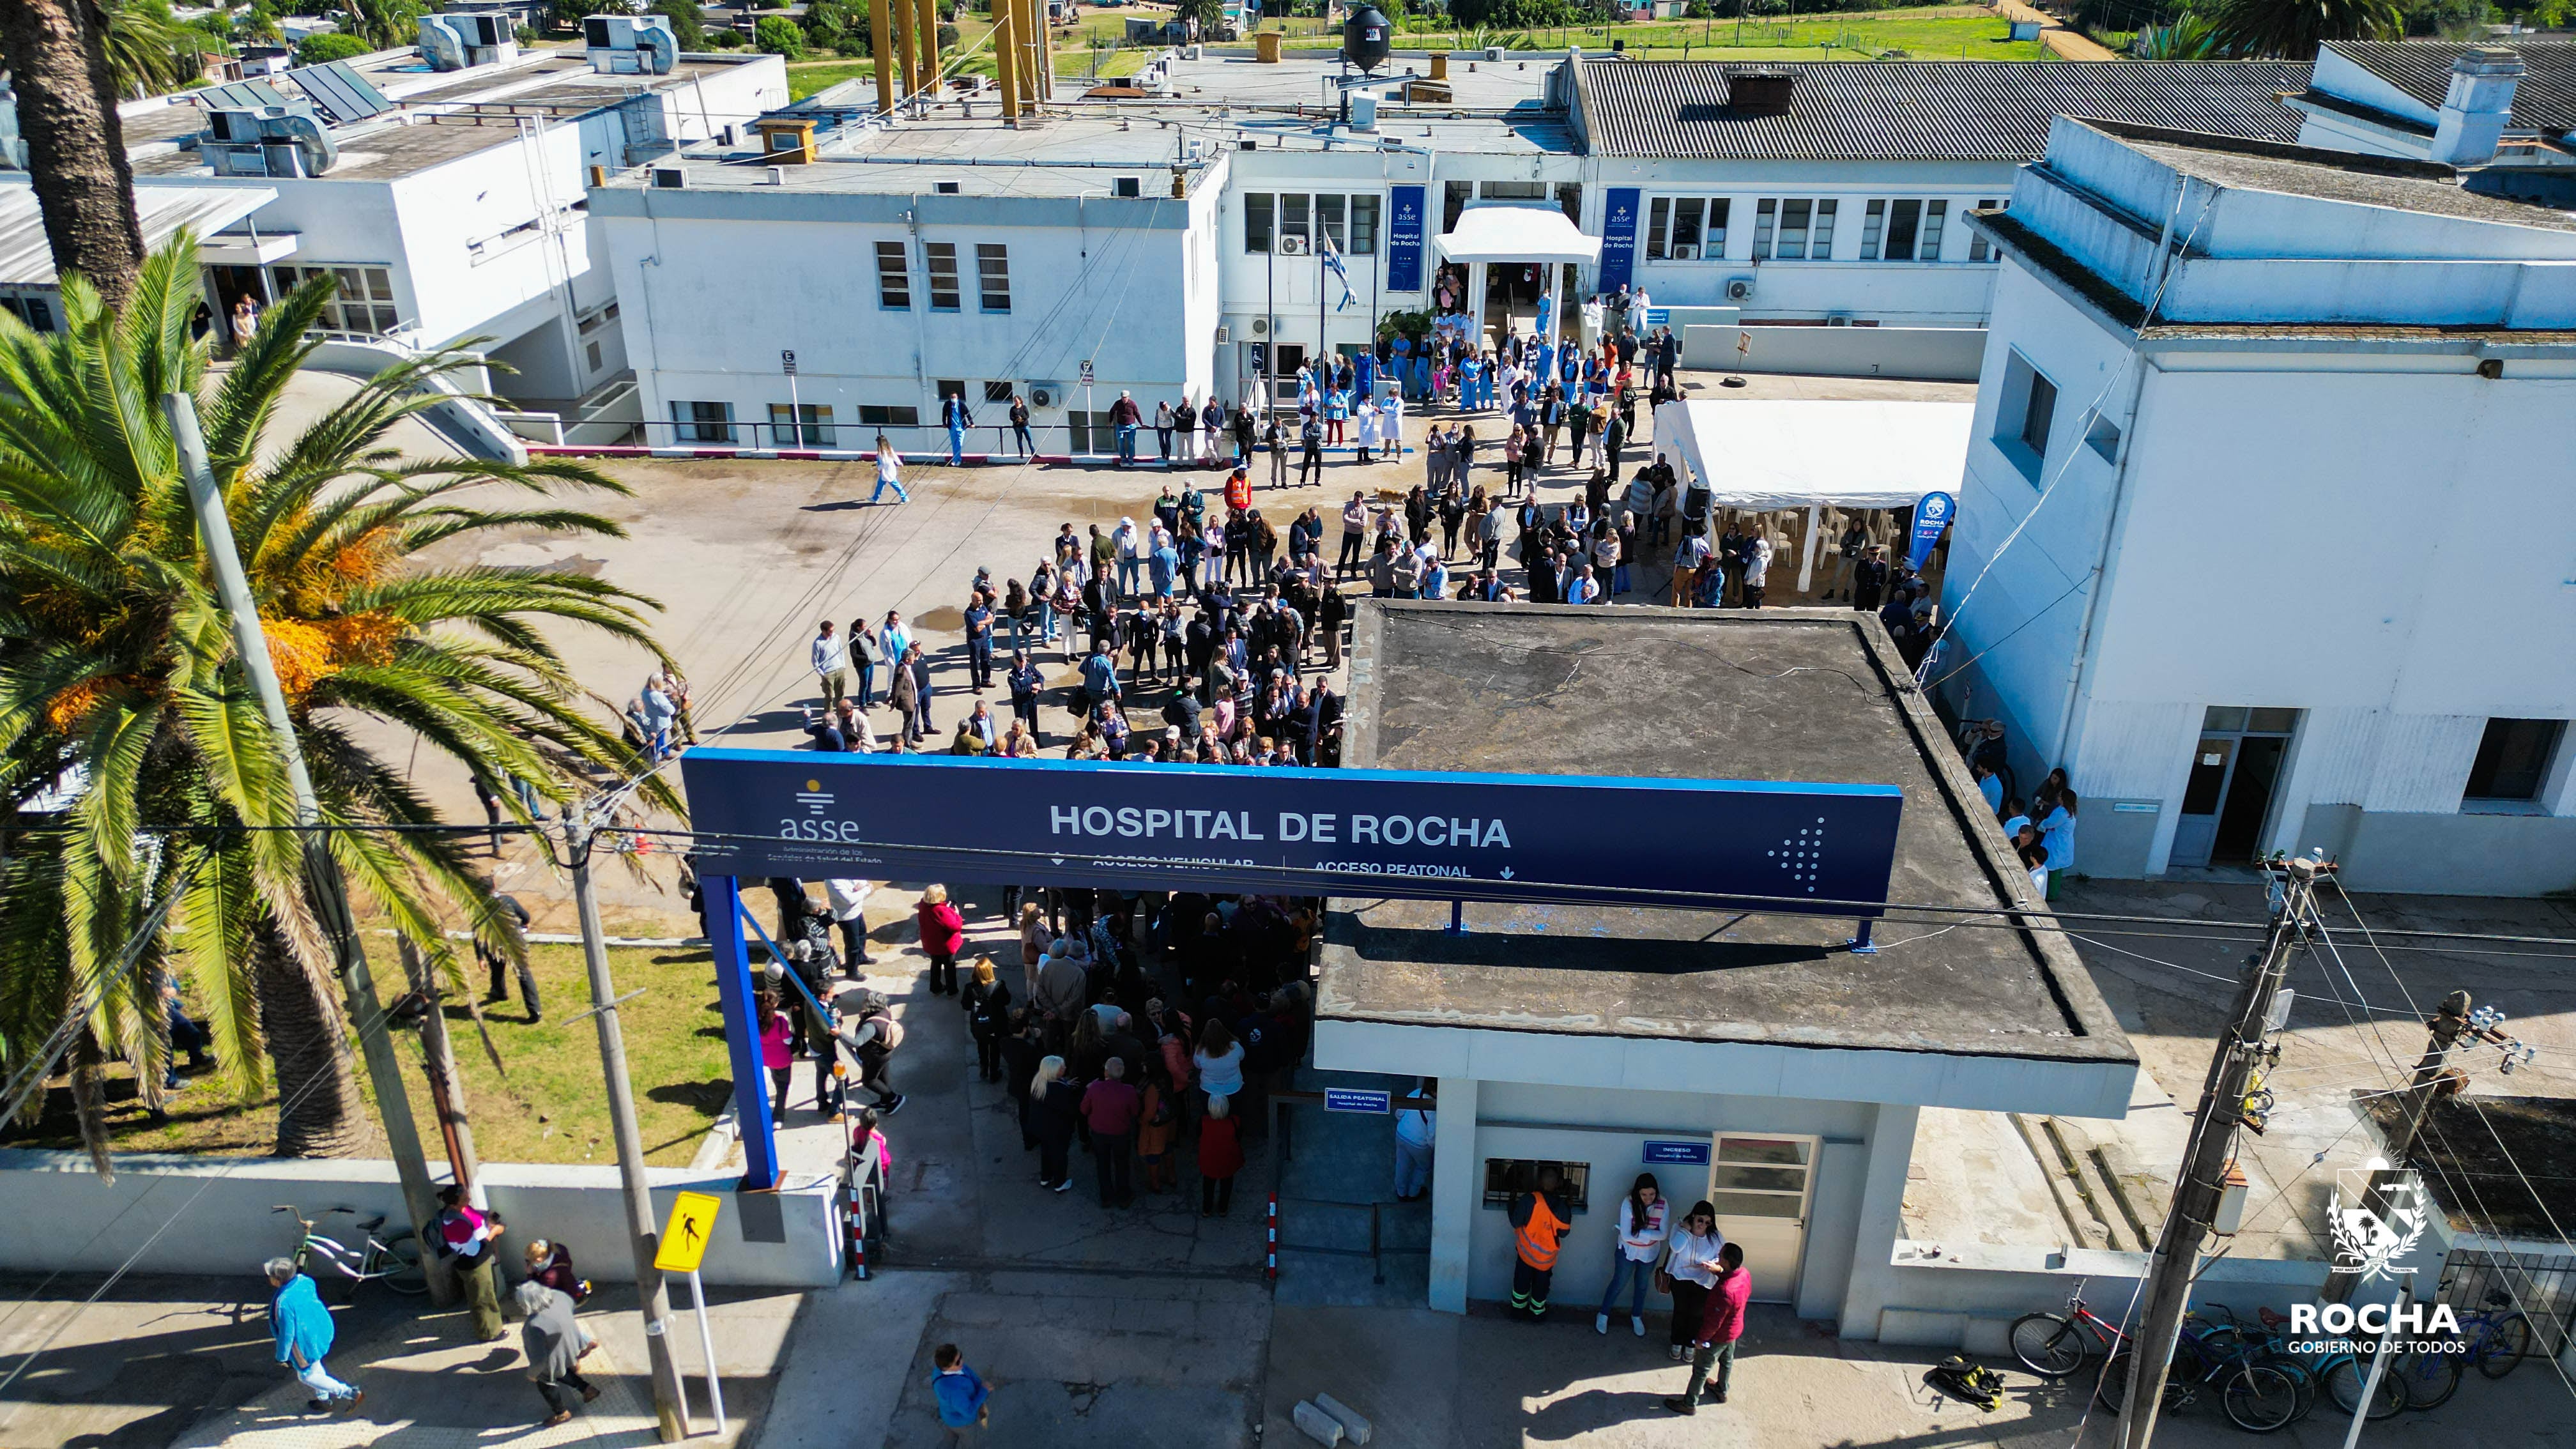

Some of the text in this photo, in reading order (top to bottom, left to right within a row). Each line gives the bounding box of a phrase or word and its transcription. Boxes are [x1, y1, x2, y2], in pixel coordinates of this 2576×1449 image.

[780, 818, 860, 843] asse
[1051, 806, 1511, 848] HOSPITAL DE ROCHA
[1315, 862, 1471, 877] ACCESO PEATONAL
